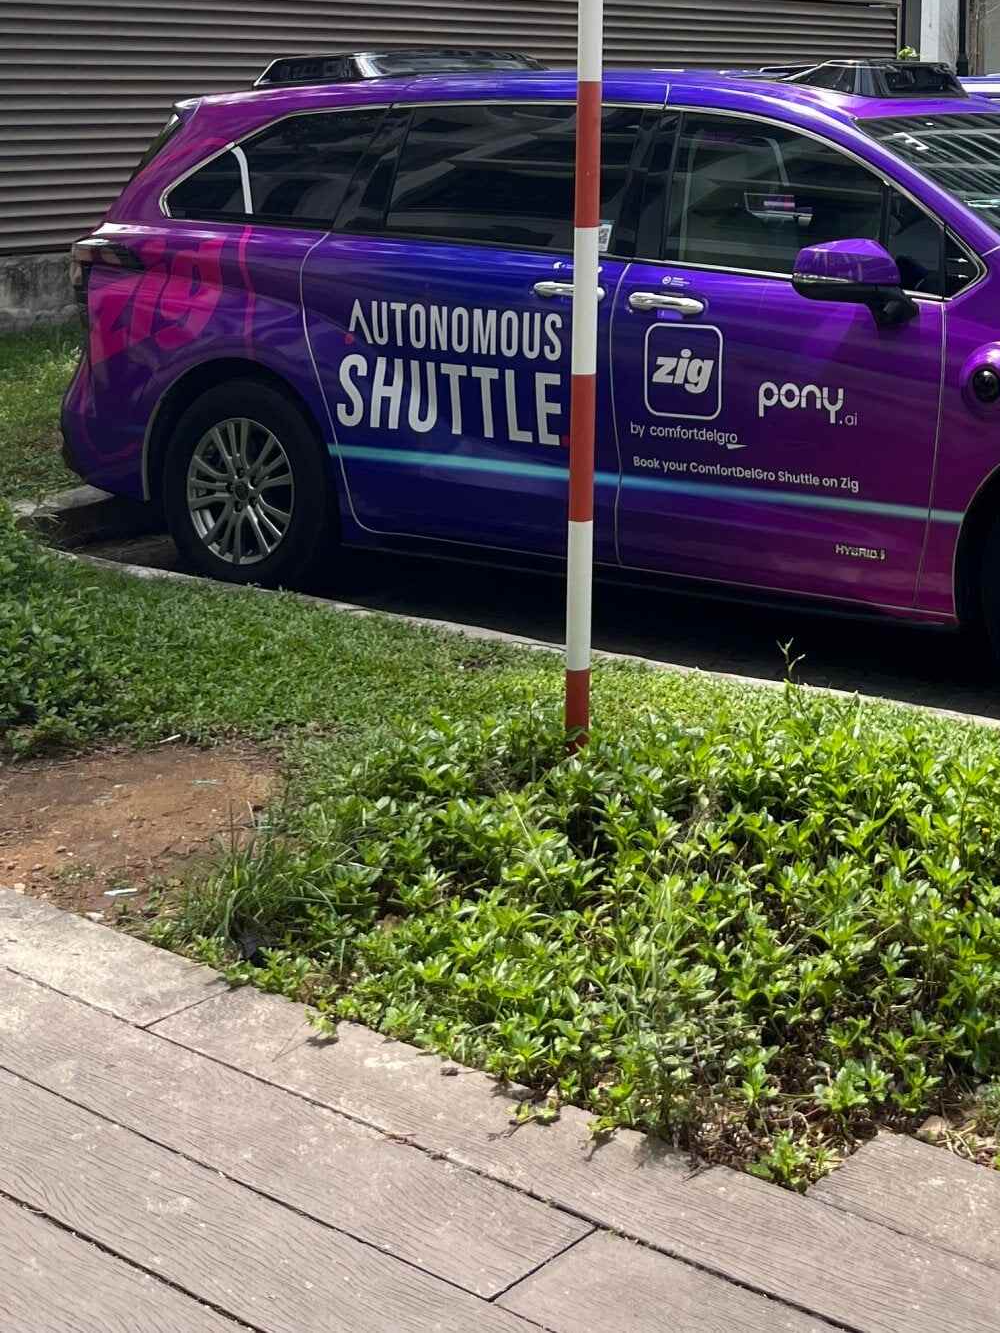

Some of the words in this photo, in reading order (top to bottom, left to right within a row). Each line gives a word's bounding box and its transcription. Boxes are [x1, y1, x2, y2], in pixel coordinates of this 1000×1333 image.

[349, 298, 563, 361] AUTONOMOUS
[652, 348, 714, 394] zig
[336, 353, 562, 446] SHUTTLE
[630, 421, 645, 438] by
[649, 426, 738, 445] comfortdelgro
[633, 455, 660, 469] Book
[662, 459, 688, 473] your
[689, 462, 776, 481] ComfortDelGro
[777, 470, 820, 486] Shuttle
[822, 478, 838, 488] on
[840, 477, 859, 493] Zig
